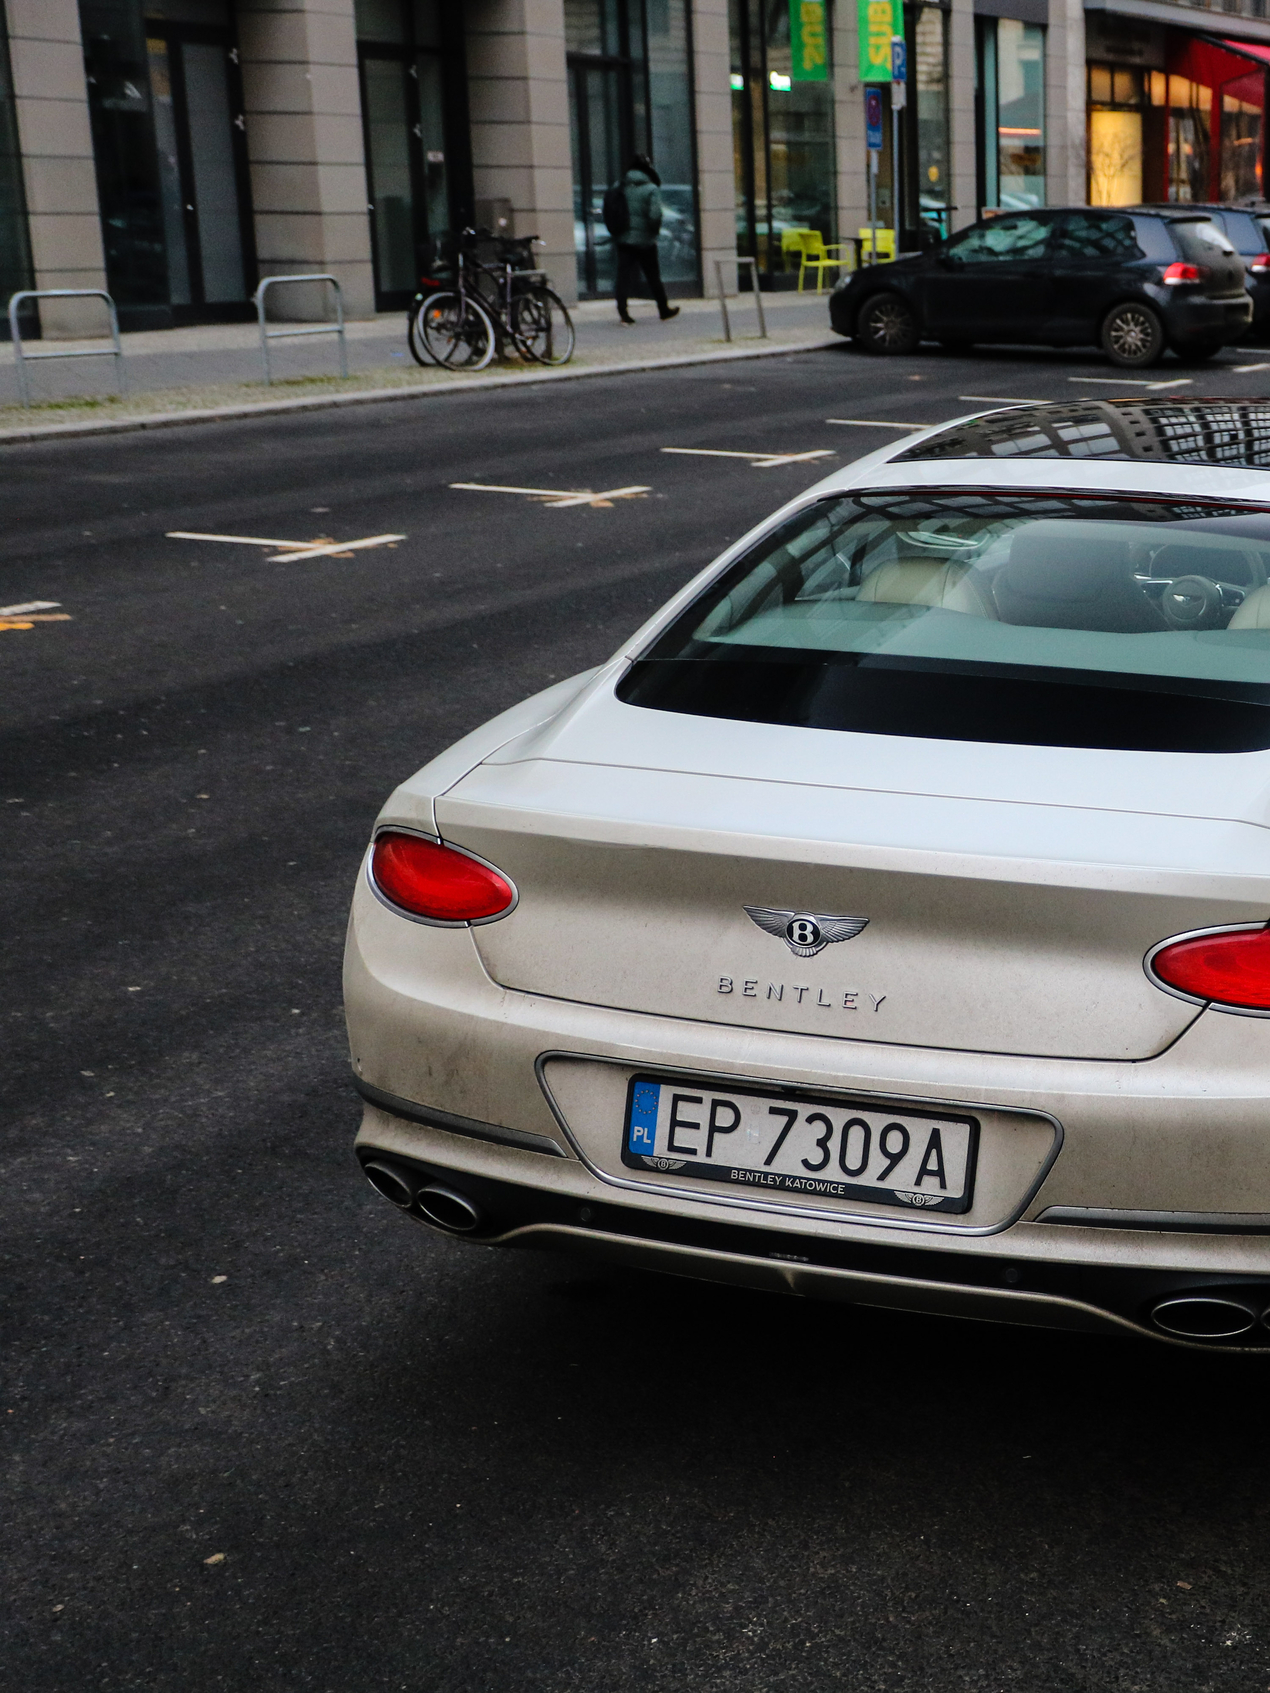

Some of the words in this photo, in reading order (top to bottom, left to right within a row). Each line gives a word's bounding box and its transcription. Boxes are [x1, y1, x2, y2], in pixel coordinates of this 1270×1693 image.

[867, 0, 894, 71] SUB
[792, 922, 815, 945] B
[717, 975, 886, 1013] BENTLEY
[633, 1127, 651, 1144] PL
[667, 1093, 741, 1157] EP
[763, 1106, 947, 1189] 7309A
[730, 1169, 783, 1187] BENTLEY
[785, 1178, 846, 1196] KATOWICE
